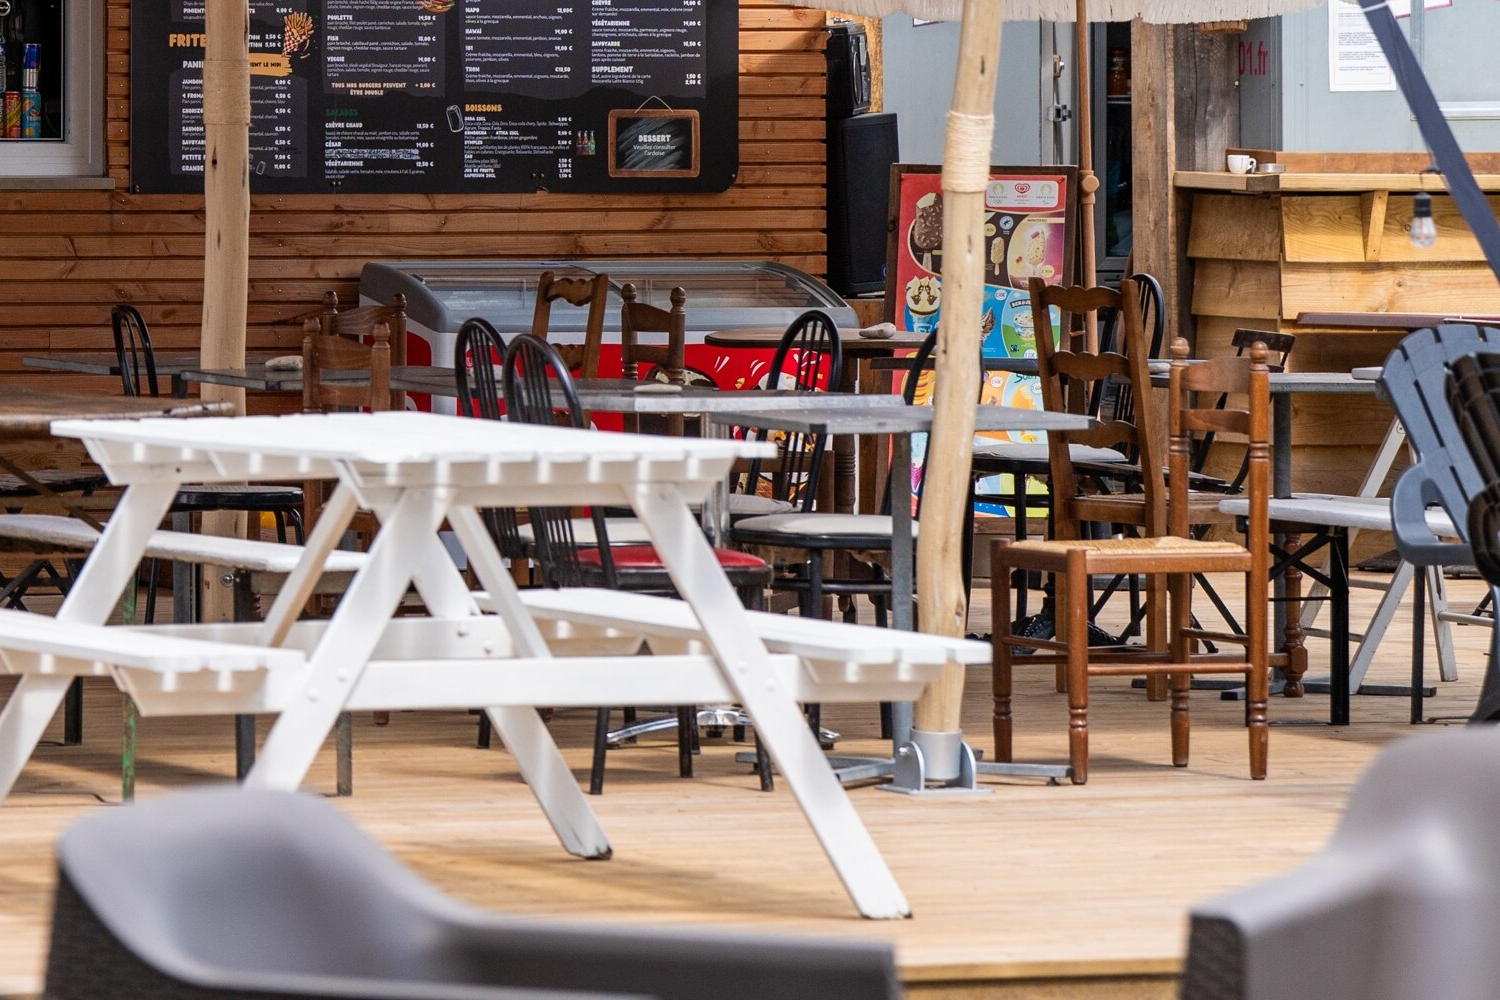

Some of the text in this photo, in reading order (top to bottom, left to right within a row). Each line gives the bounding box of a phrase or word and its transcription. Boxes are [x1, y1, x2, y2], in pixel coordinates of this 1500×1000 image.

[169, 33, 208, 48] FRITE
[465, 104, 503, 112] BOISSONS
[638, 135, 672, 143] DESSERT
